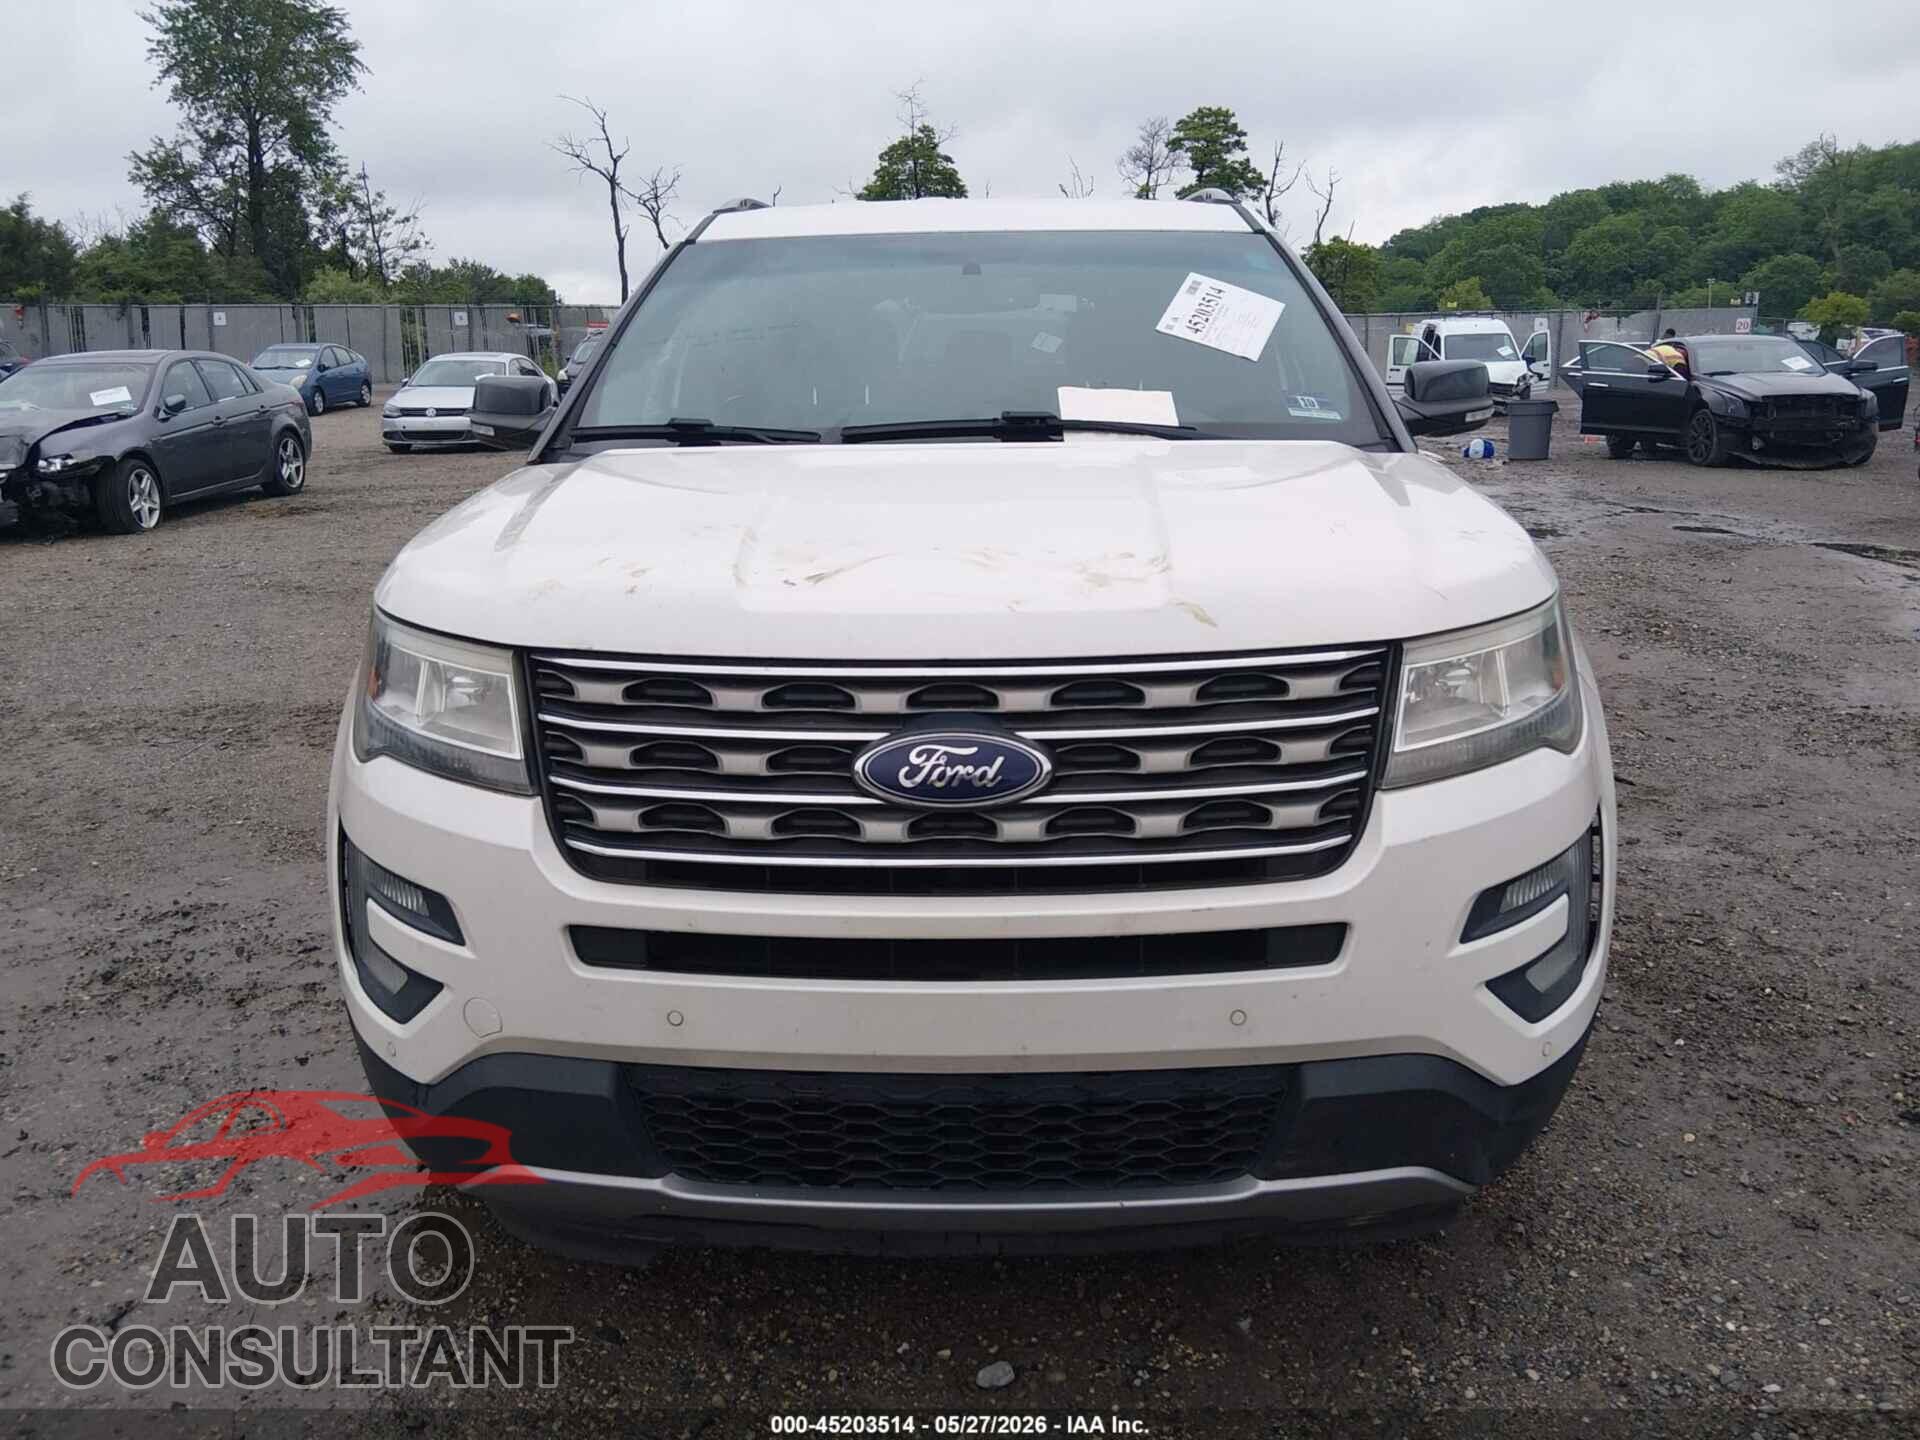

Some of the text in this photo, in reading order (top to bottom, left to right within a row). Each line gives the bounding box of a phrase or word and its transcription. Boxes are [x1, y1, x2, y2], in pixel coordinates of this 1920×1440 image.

[1186, 286, 1226, 334] 45203514
[1737, 320, 1750, 330] 20
[898, 744, 1005, 788] Ford
